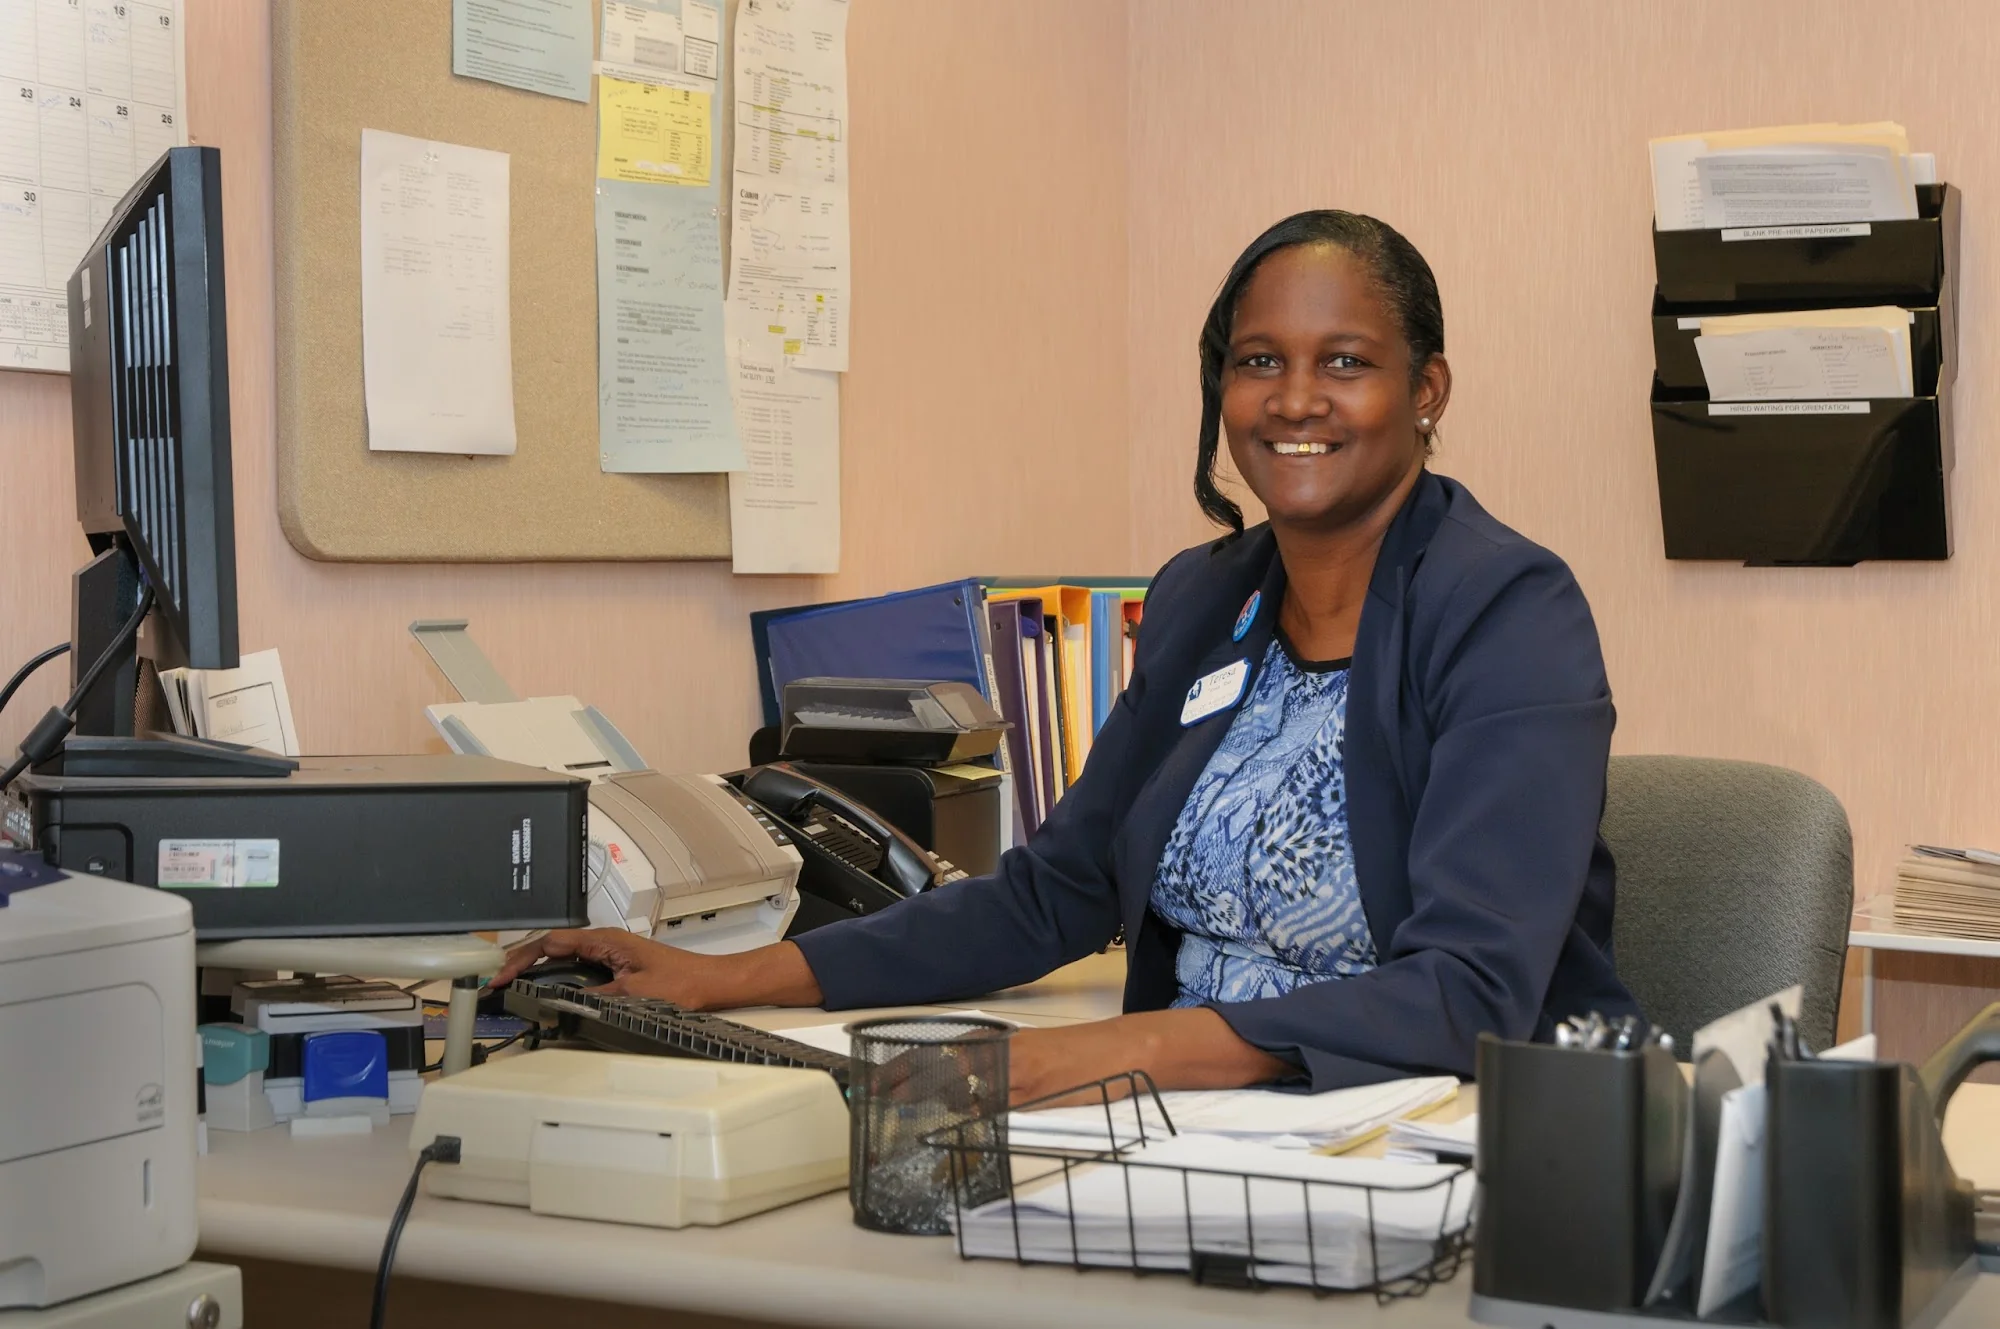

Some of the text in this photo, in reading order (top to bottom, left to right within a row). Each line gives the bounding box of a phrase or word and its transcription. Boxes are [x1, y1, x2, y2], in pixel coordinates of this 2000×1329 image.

[113, 5, 125, 17] 18
[158, 15, 170, 27] 19
[20, 87, 33, 99] 23
[69, 96, 82, 108] 24
[116, 105, 129, 117] 25
[161, 113, 173, 125] 26
[23, 191, 36, 202] 30
[740, 188, 759, 201] Canon
[1743, 229, 1767, 238] BLANK
[1804, 225, 1851, 235] PAPERWORK
[1730, 403, 1850, 413] HIRED WAITING FOR ORIENTATION
